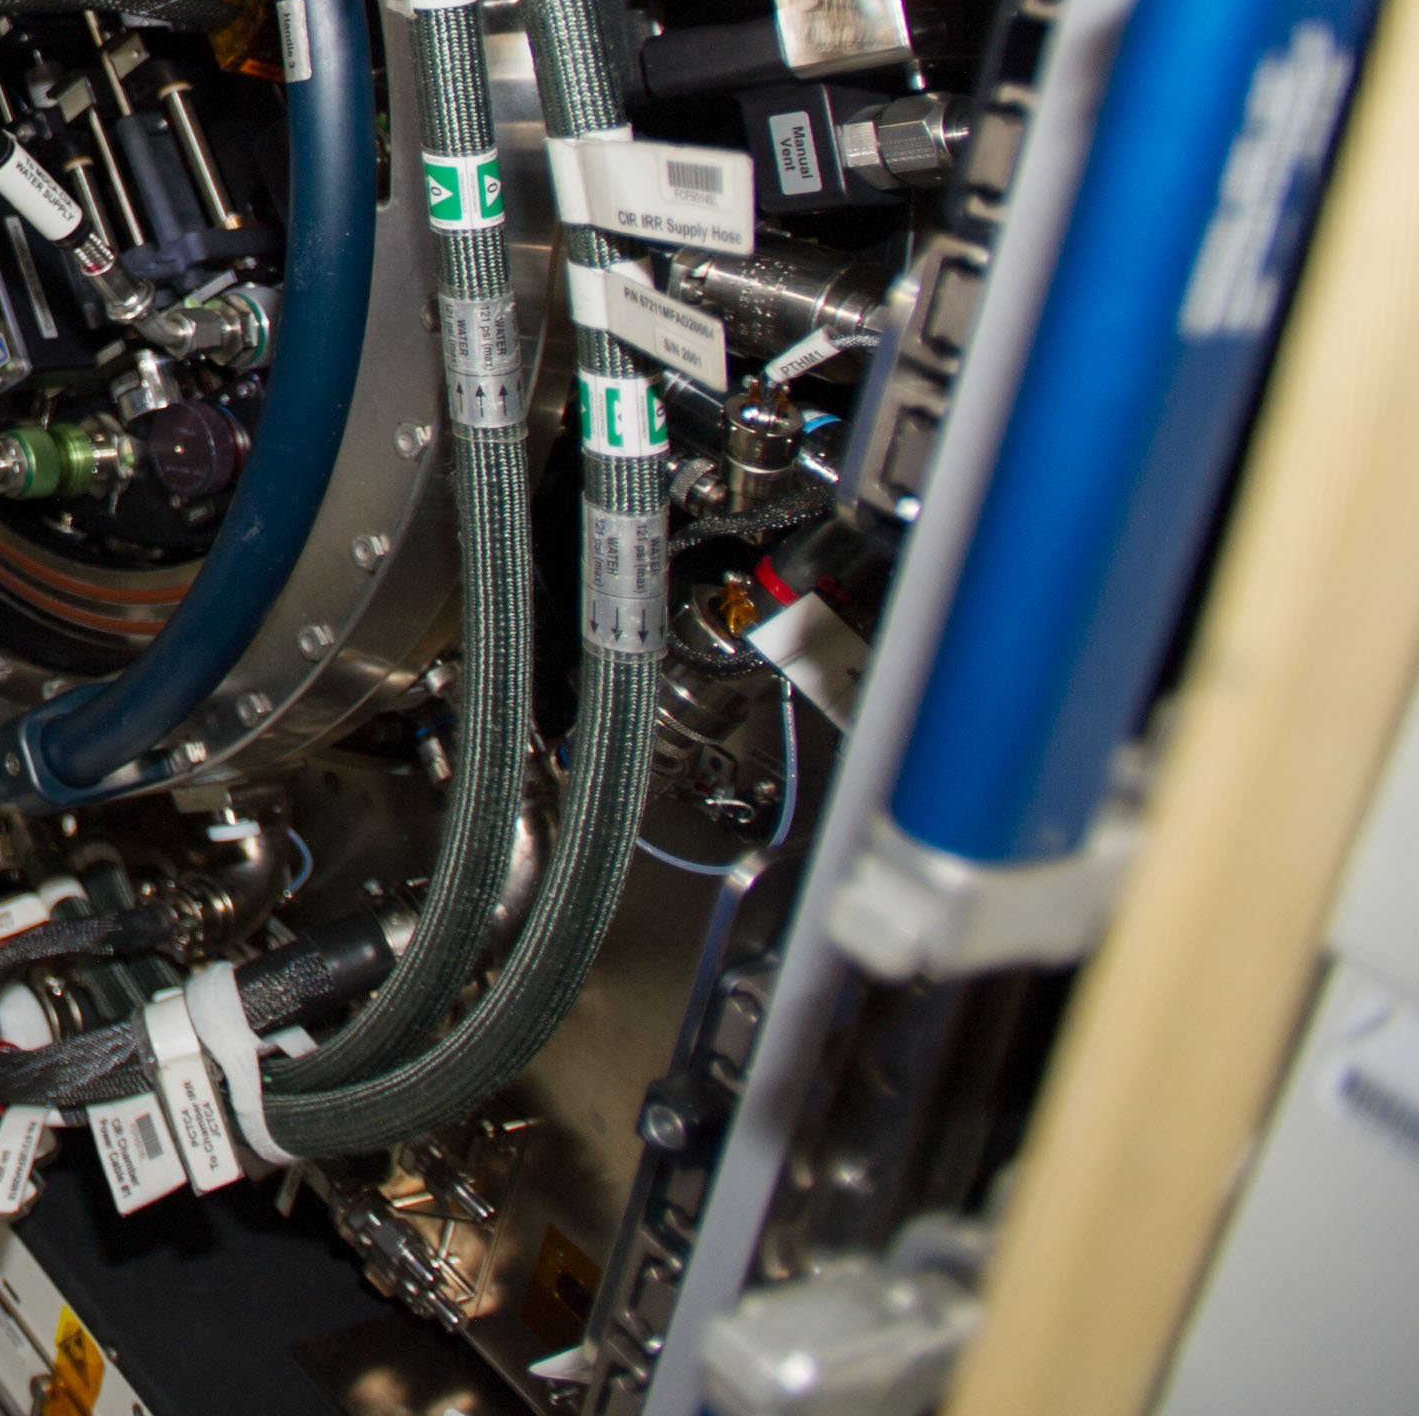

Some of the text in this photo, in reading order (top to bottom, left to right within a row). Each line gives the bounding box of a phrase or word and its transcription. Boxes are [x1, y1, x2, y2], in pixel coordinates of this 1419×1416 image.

[283, 12, 295, 57] Handle
[780, 136, 796, 172] Vent
[792, 125, 814, 179] Manual
[15, 160, 75, 221] WATER SUPPLY
[618, 210, 743, 245] CIR IRR Supply Hose
[480, 305, 491, 322] 121
[457, 319, 469, 357] WATER
[480, 325, 493, 340] psi
[495, 318, 508, 356] WATER
[779, 349, 824, 377] PTHM1
[193, 1103, 213, 1153] Chamber
[108, 1151, 124, 1183] Cable
[117, 1138, 140, 1186] Chamber
[209, 1155, 219, 1171] To
